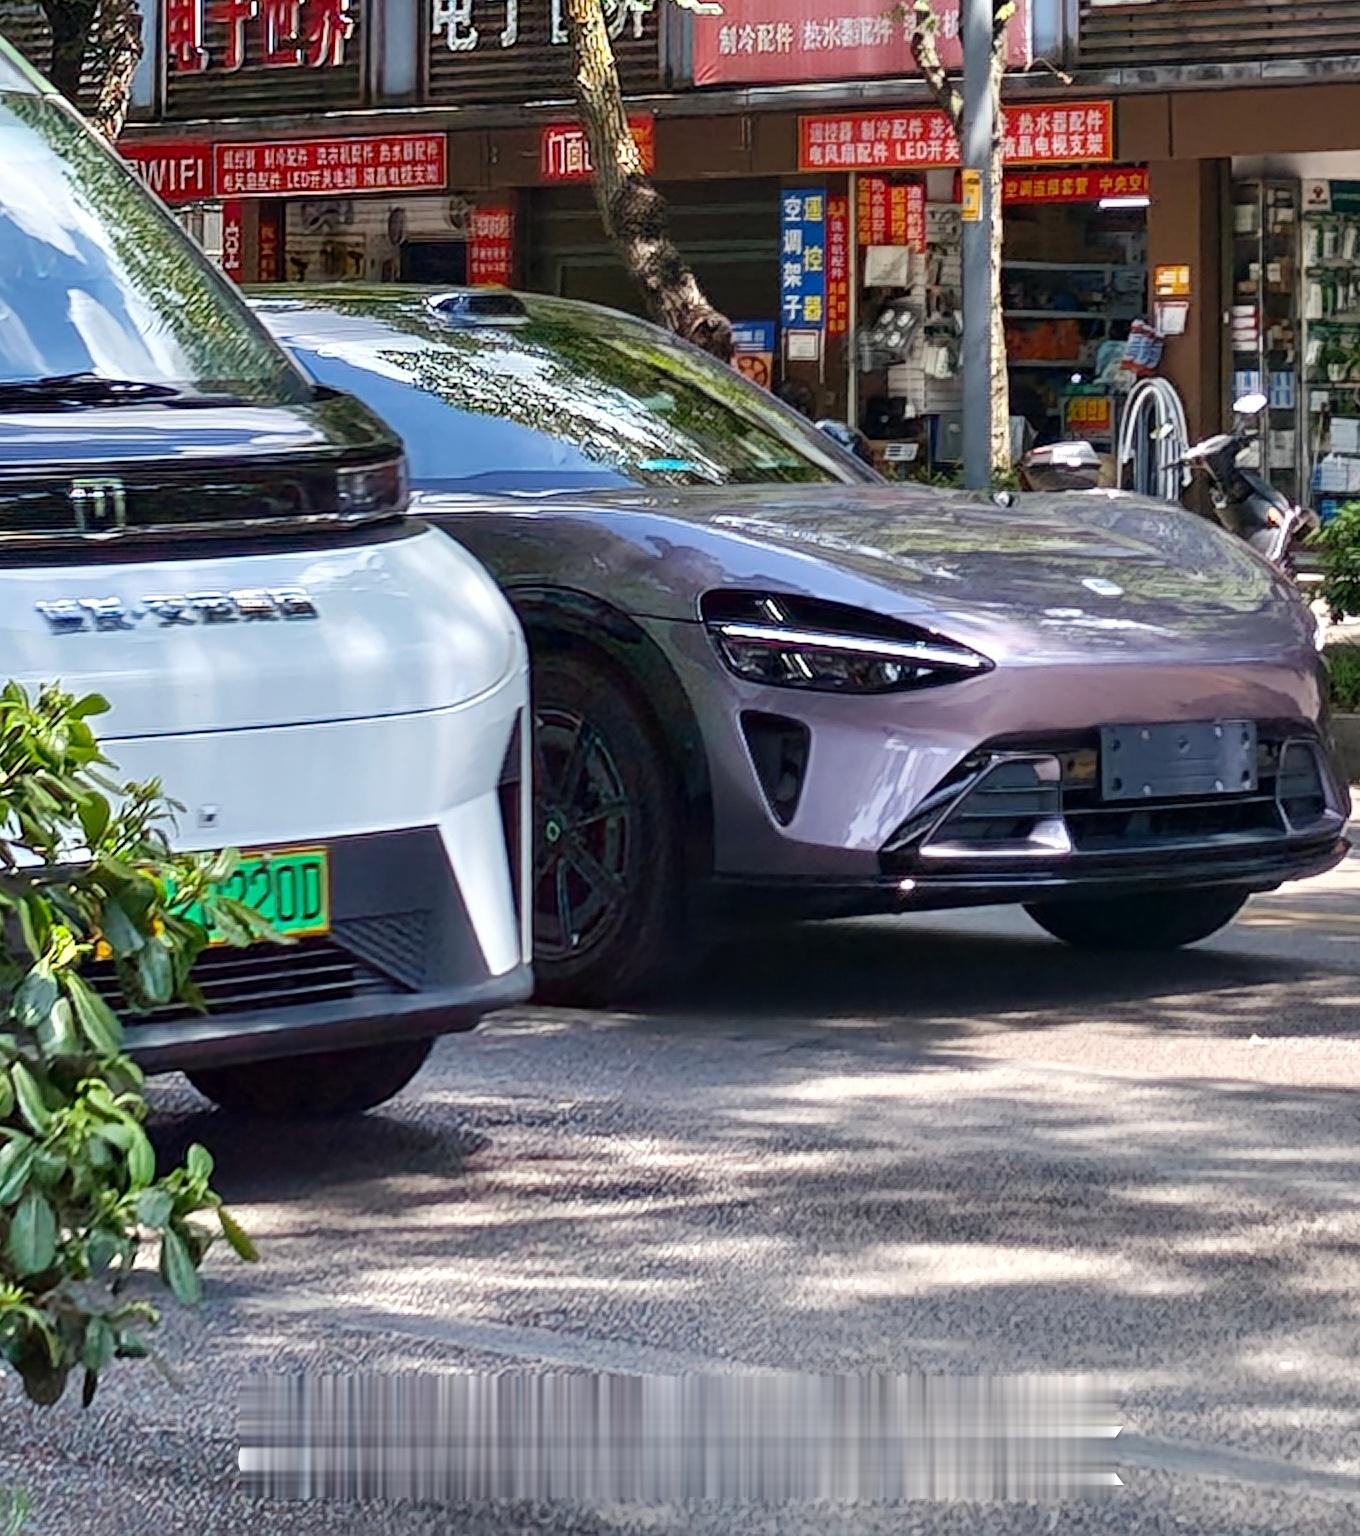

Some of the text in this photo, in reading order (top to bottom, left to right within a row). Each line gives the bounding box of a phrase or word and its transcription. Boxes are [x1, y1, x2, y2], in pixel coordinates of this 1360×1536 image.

[719, 20, 793, 56] 制冷配件
[860, 117, 925, 142] 制冷配件
[1017, 108, 1104, 135] 热水器配件
[783, 196, 803, 321] 空调架子
